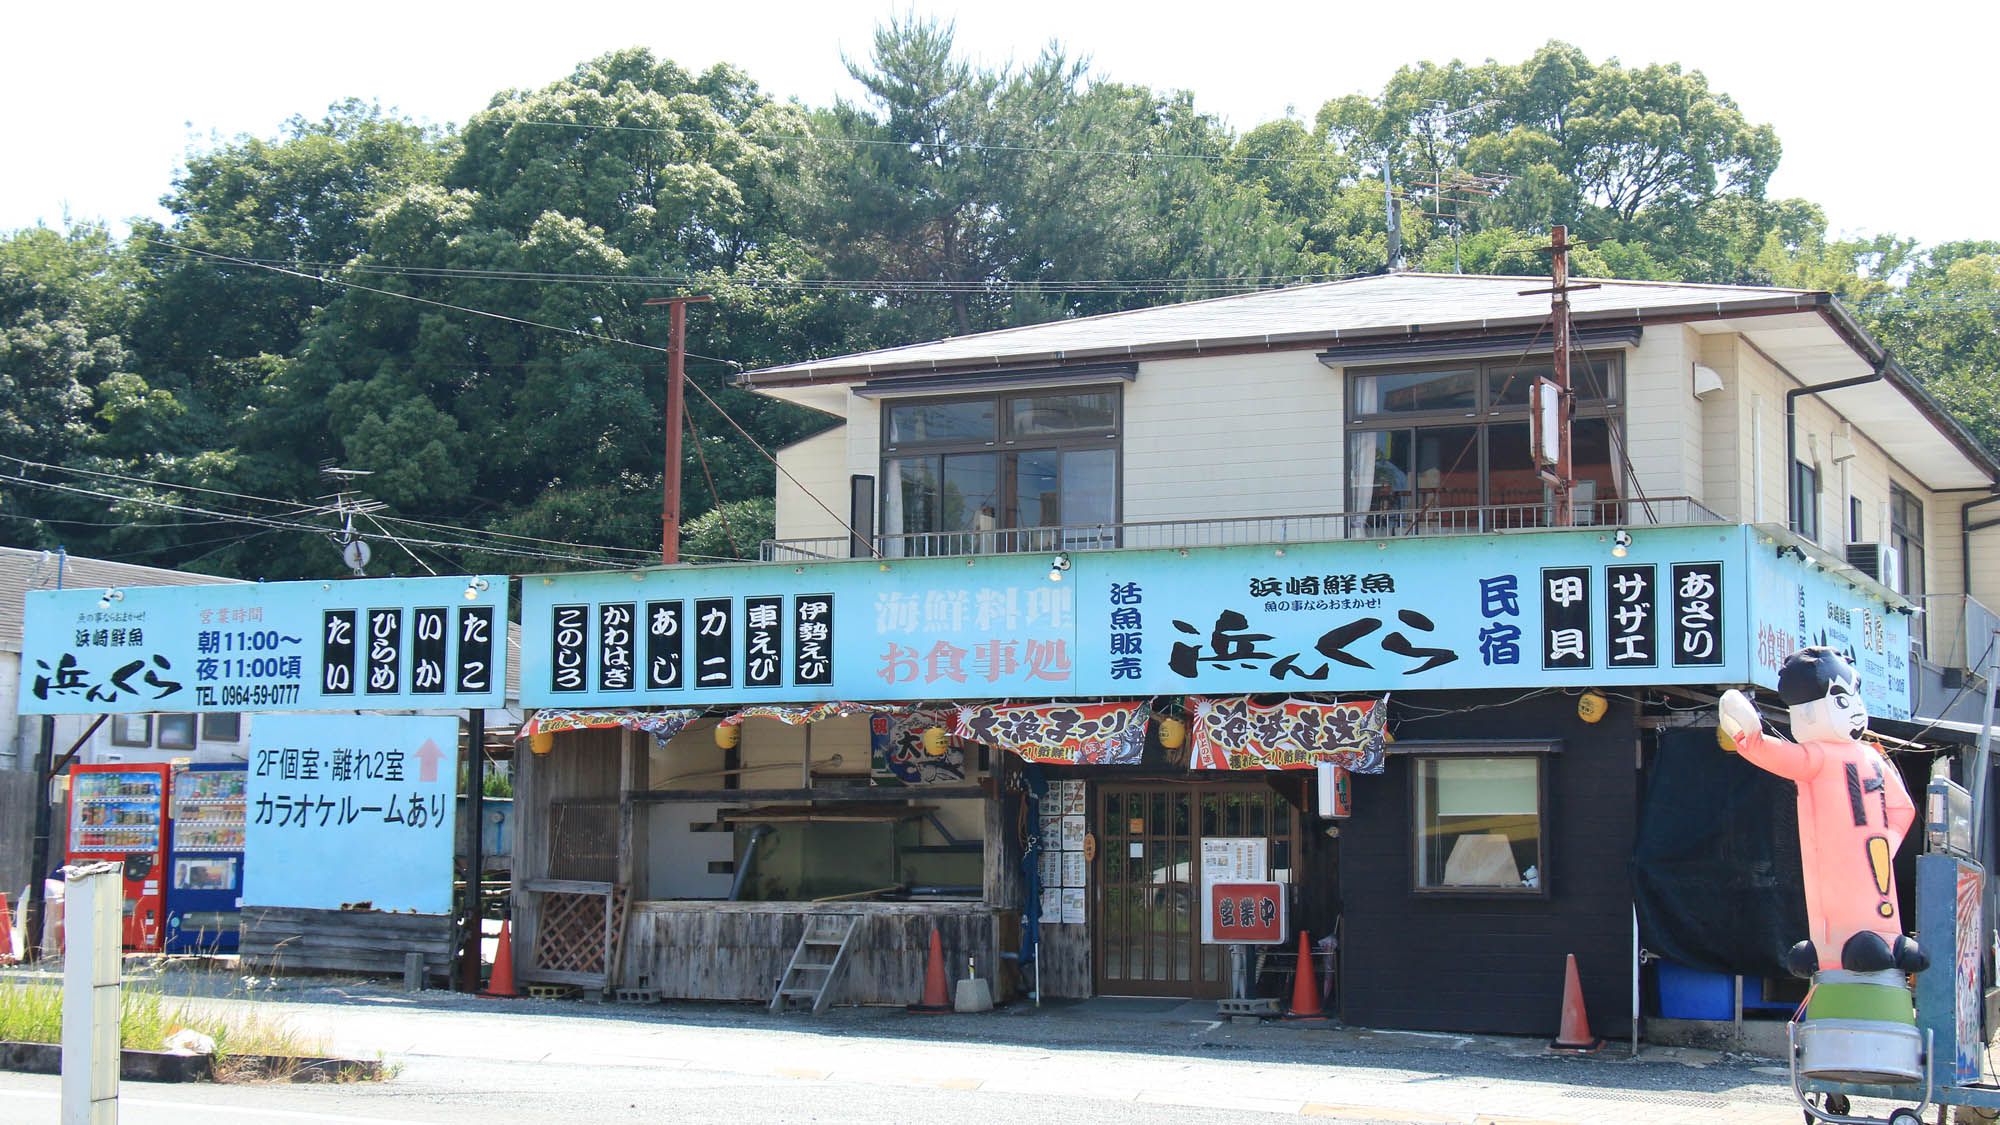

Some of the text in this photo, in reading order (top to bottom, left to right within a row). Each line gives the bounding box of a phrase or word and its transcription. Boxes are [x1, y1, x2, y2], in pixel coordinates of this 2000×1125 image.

[199, 607, 264, 624] 営業時間
[874, 587, 1073, 637] 海鮮料理
[1249, 574, 1396, 598] 浜崎鮮魚
[1264, 597, 1382, 613] 魚の事ならおまかせ!
[1478, 574, 1521, 666] 民宿
[1549, 575, 1585, 661] 甲貝
[1612, 572, 1651, 661] サザエ
[1679, 570, 1716, 658] あさり
[75, 627, 143, 648] 浜崎鮮魚
[195, 656, 302, 681] 夜11:00頃
[327, 615, 351, 690] たい
[371, 612, 397, 690] ひらめ
[416, 613, 442, 688] いか
[462, 612, 489, 689] たこ
[556, 609, 583, 688] このしろ
[603, 605, 630, 686] かわはぎ
[650, 606, 678, 685] あじ
[700, 606, 727, 682] カニ
[748, 604, 778, 683] 車えび
[799, 601, 830, 681] 伊勢えび
[877, 639, 1073, 686] お食事処
[1109, 581, 1143, 681] 活魚販売
[196, 684, 301, 706] TEL 0964-59-0777
[254, 792, 447, 829] カラオケルームあり
[1219, 896, 1277, 928] 営業中
